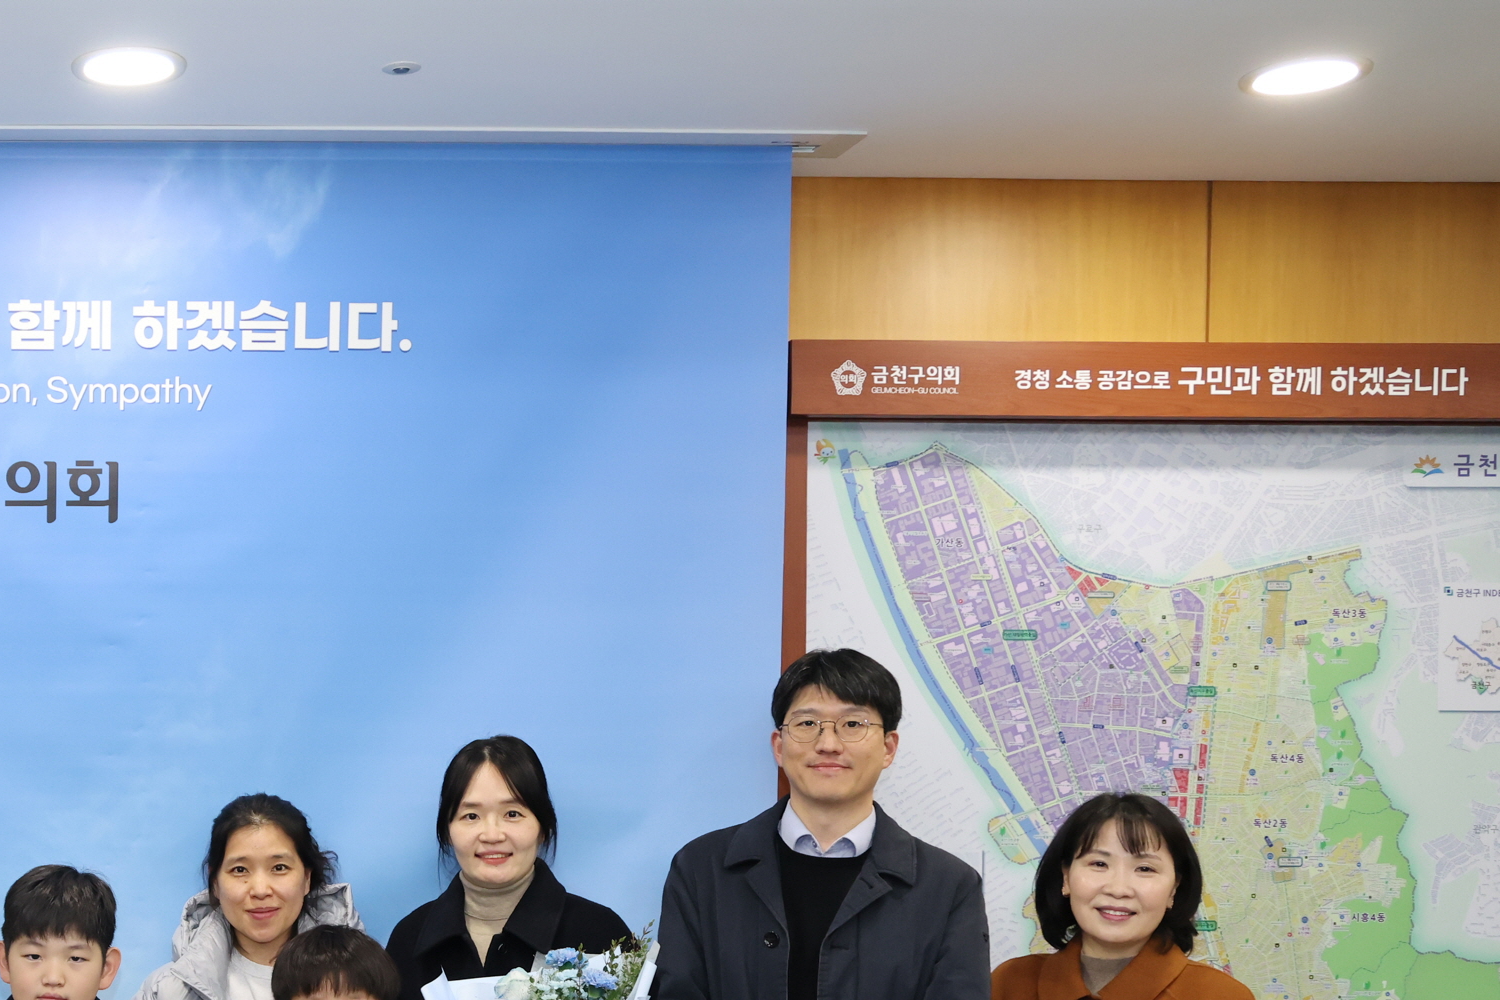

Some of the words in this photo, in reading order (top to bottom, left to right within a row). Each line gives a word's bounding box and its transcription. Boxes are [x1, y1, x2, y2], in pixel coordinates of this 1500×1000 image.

[7, 299, 112, 351] 함께
[132, 299, 412, 353] 하겠습니다.
[871, 365, 960, 385] 금천구의회
[1014, 369, 1050, 390] 경청
[1055, 370, 1093, 390] 소통
[1097, 370, 1171, 391] 공감으로
[1177, 365, 1261, 395] 구민과
[1268, 366, 1322, 396] 함께
[1330, 366, 1469, 396] 하겠습니다
[46, 376, 213, 411] Sympathy
[929, 386, 959, 394] COUNCIL
[935, 537, 964, 548] 가산동
[1332, 608, 1367, 618] 독산3동
[1270, 753, 1305, 763] 독산4동
[1252, 818, 1288, 829] 독산2동
[1351, 912, 1386, 923] 시흥4동
